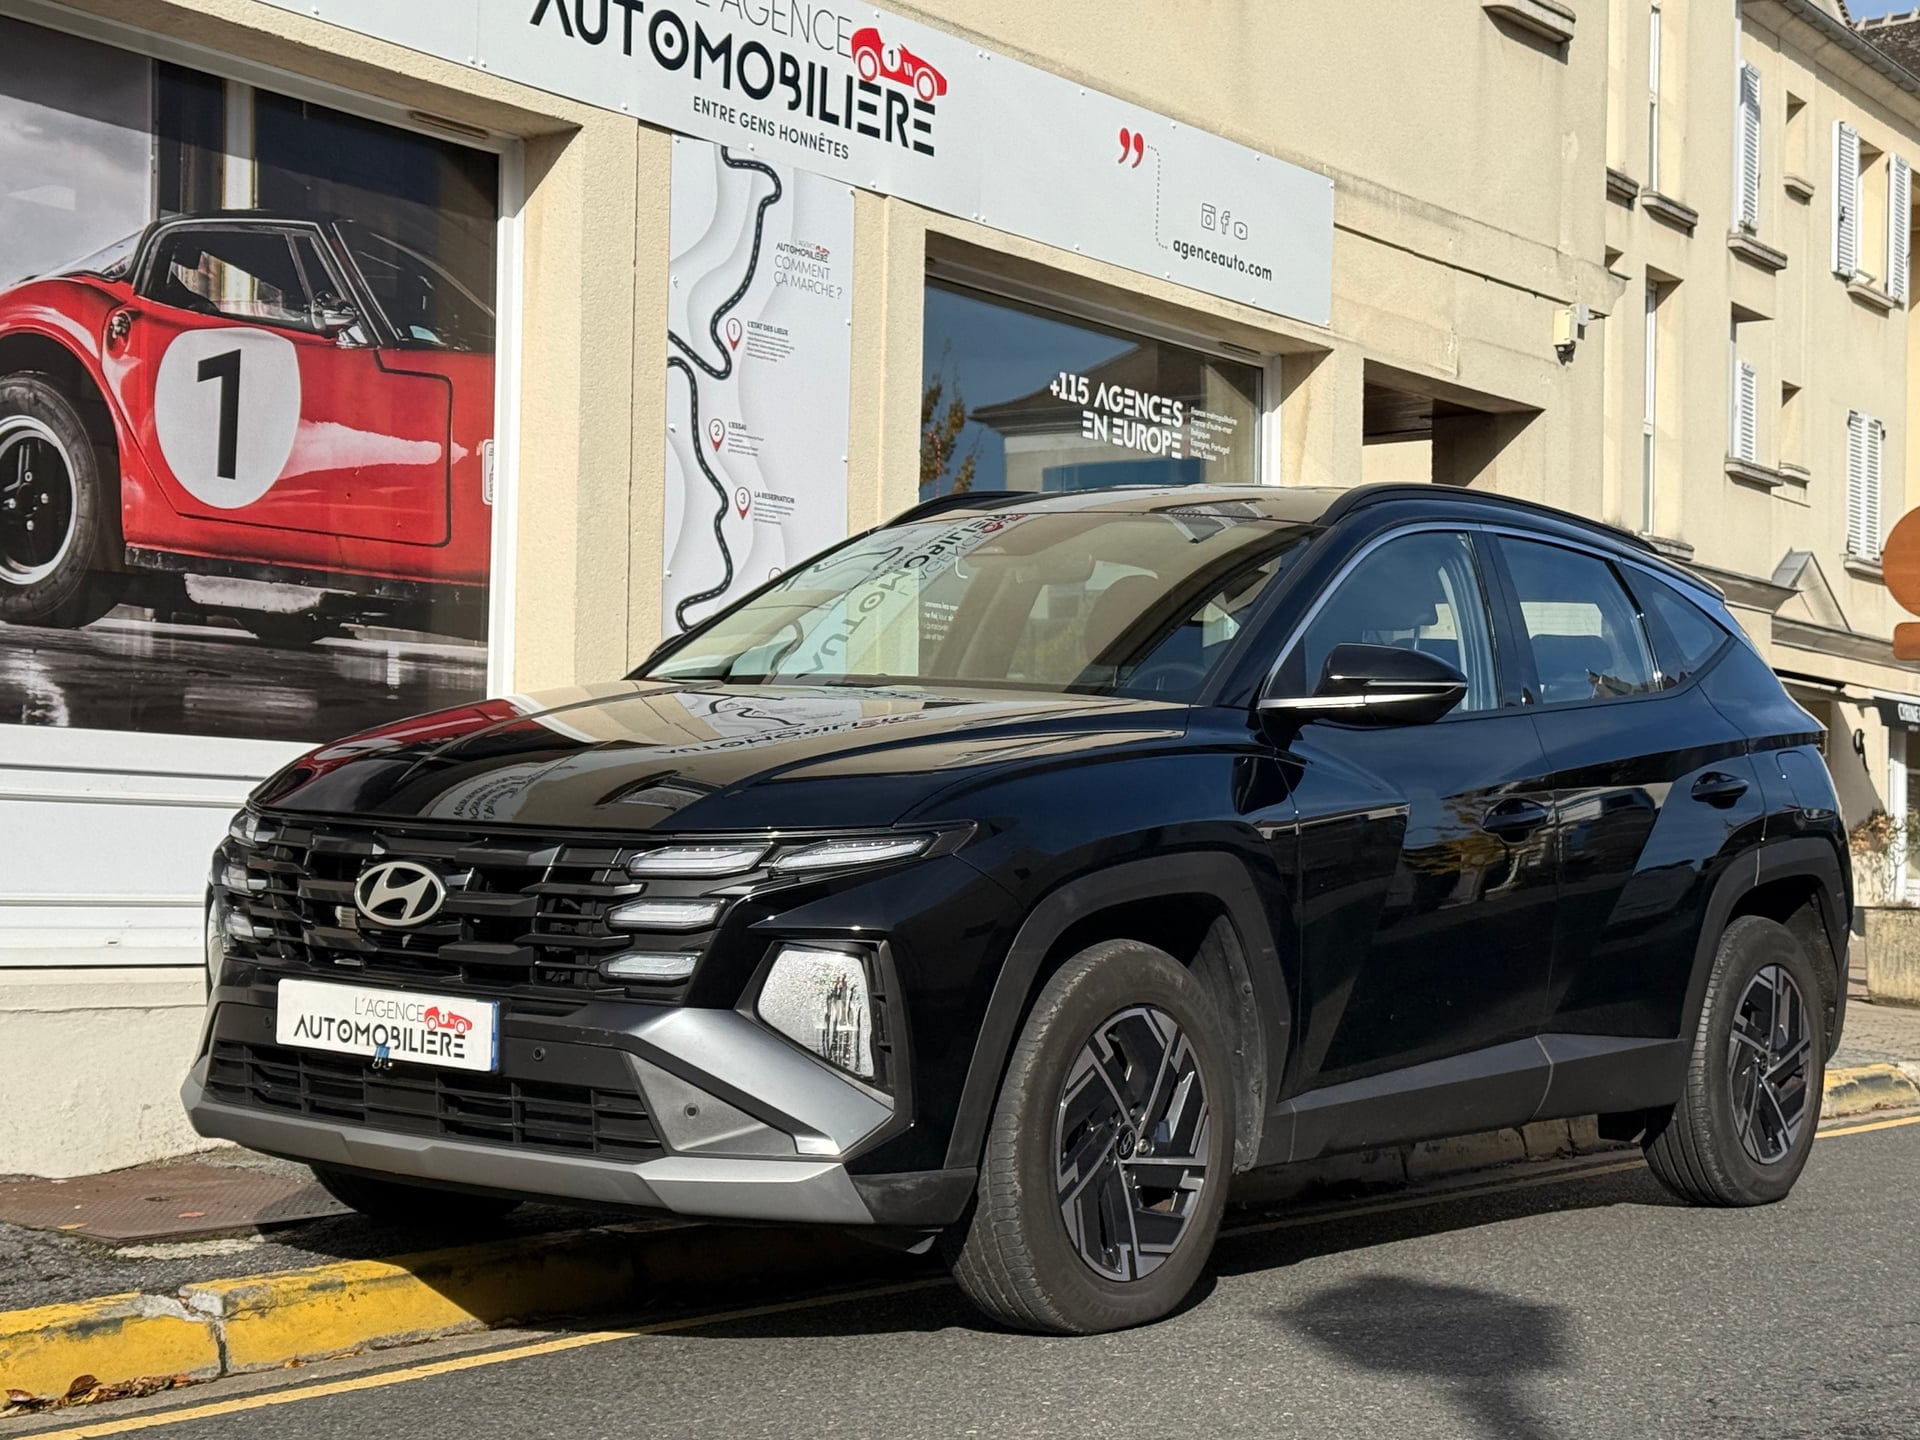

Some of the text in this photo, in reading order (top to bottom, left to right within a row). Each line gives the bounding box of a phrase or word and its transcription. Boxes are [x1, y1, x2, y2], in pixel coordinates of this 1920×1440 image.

[693, 95, 850, 160] ENTRE GENS HONNÊTES
[775, 255, 831, 280] COMMENT
[1173, 240, 1272, 280] agenceauto.com
[774, 271, 843, 300] ÇA MARCHE ?
[197, 348, 241, 480] 1
[1050, 372, 1183, 428] +115 AGENCES
[713, 424, 720, 437] 2
[1082, 410, 1182, 460] EN EUROPE
[740, 493, 746, 505] 3
[354, 996, 425, 1023] L'AGENCE
